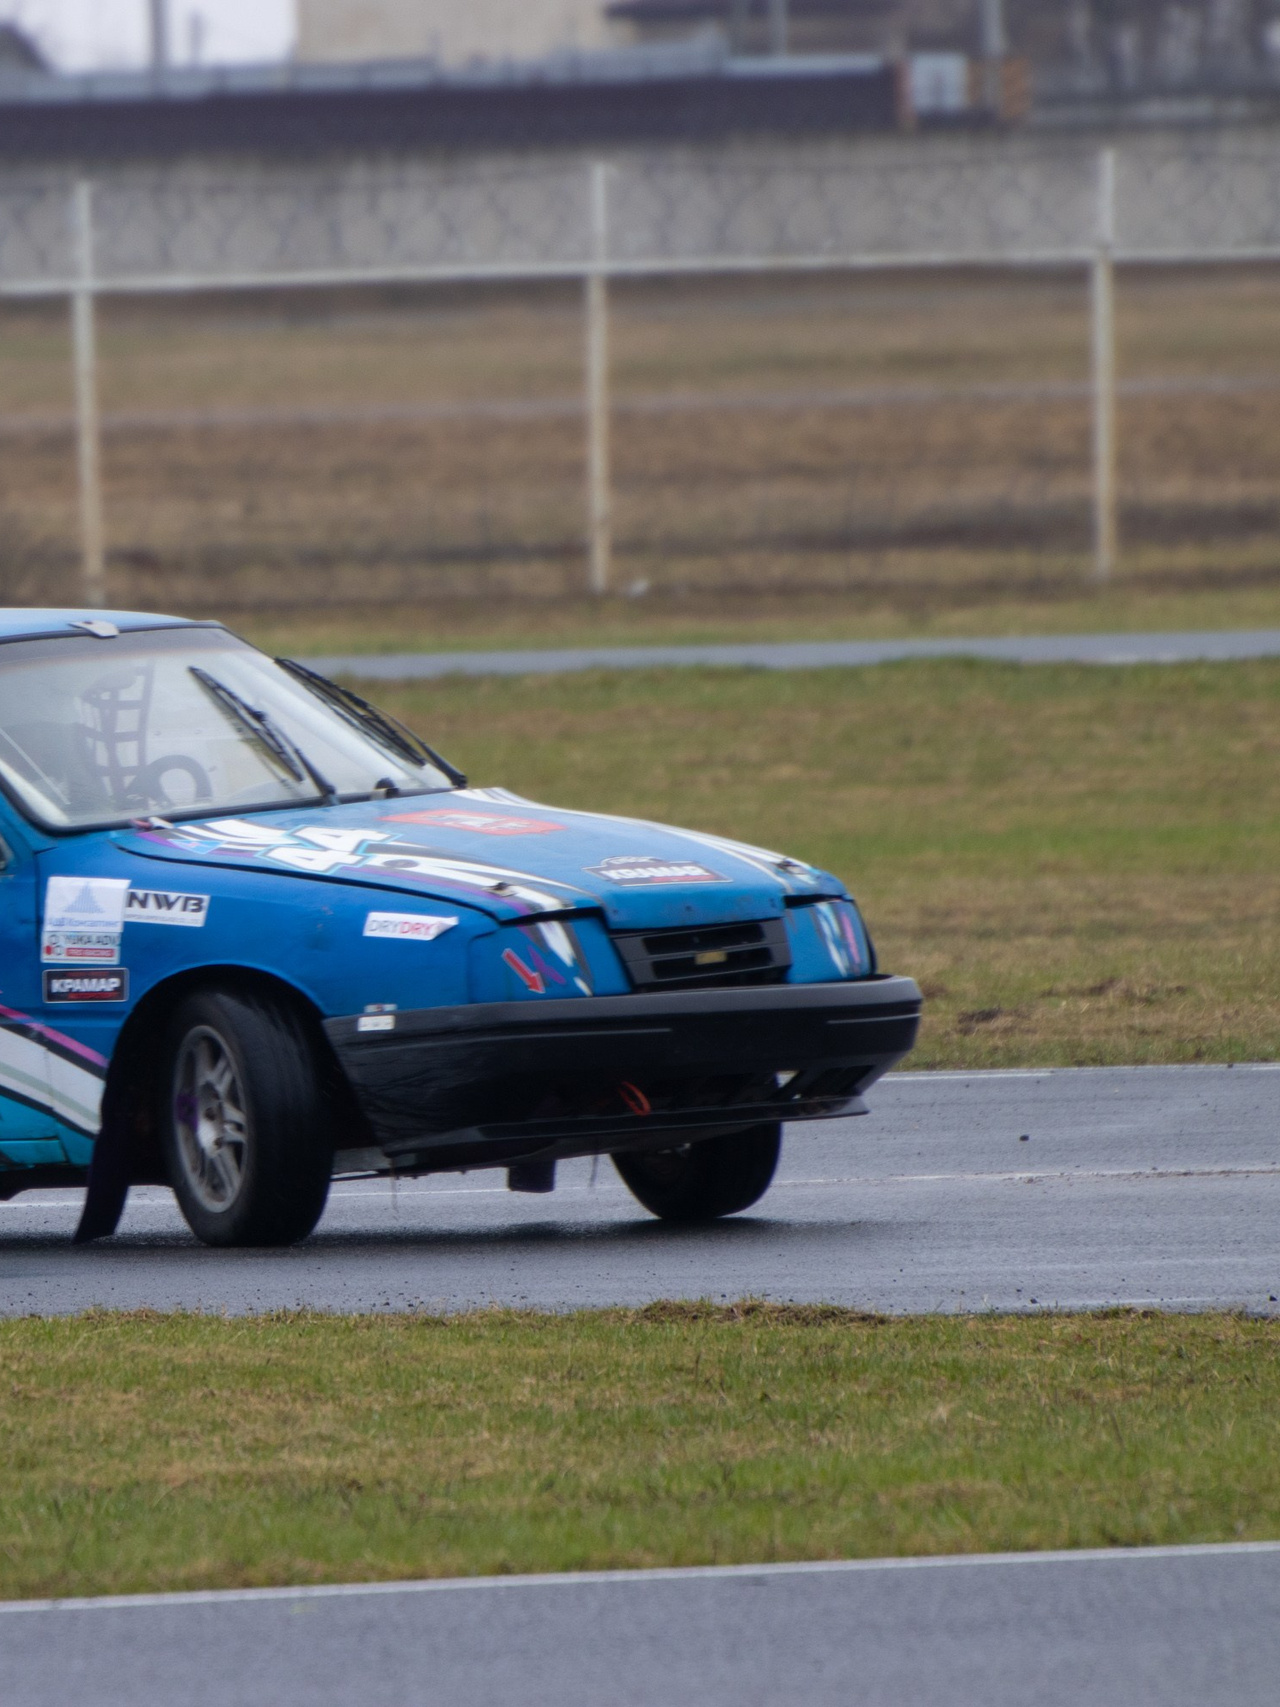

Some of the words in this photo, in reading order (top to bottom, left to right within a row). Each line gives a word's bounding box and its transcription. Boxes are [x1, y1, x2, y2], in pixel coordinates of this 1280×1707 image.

[262, 825, 397, 872] 44
[126, 891, 205, 914] NWB
[51, 978, 121, 993] КРАМАР
